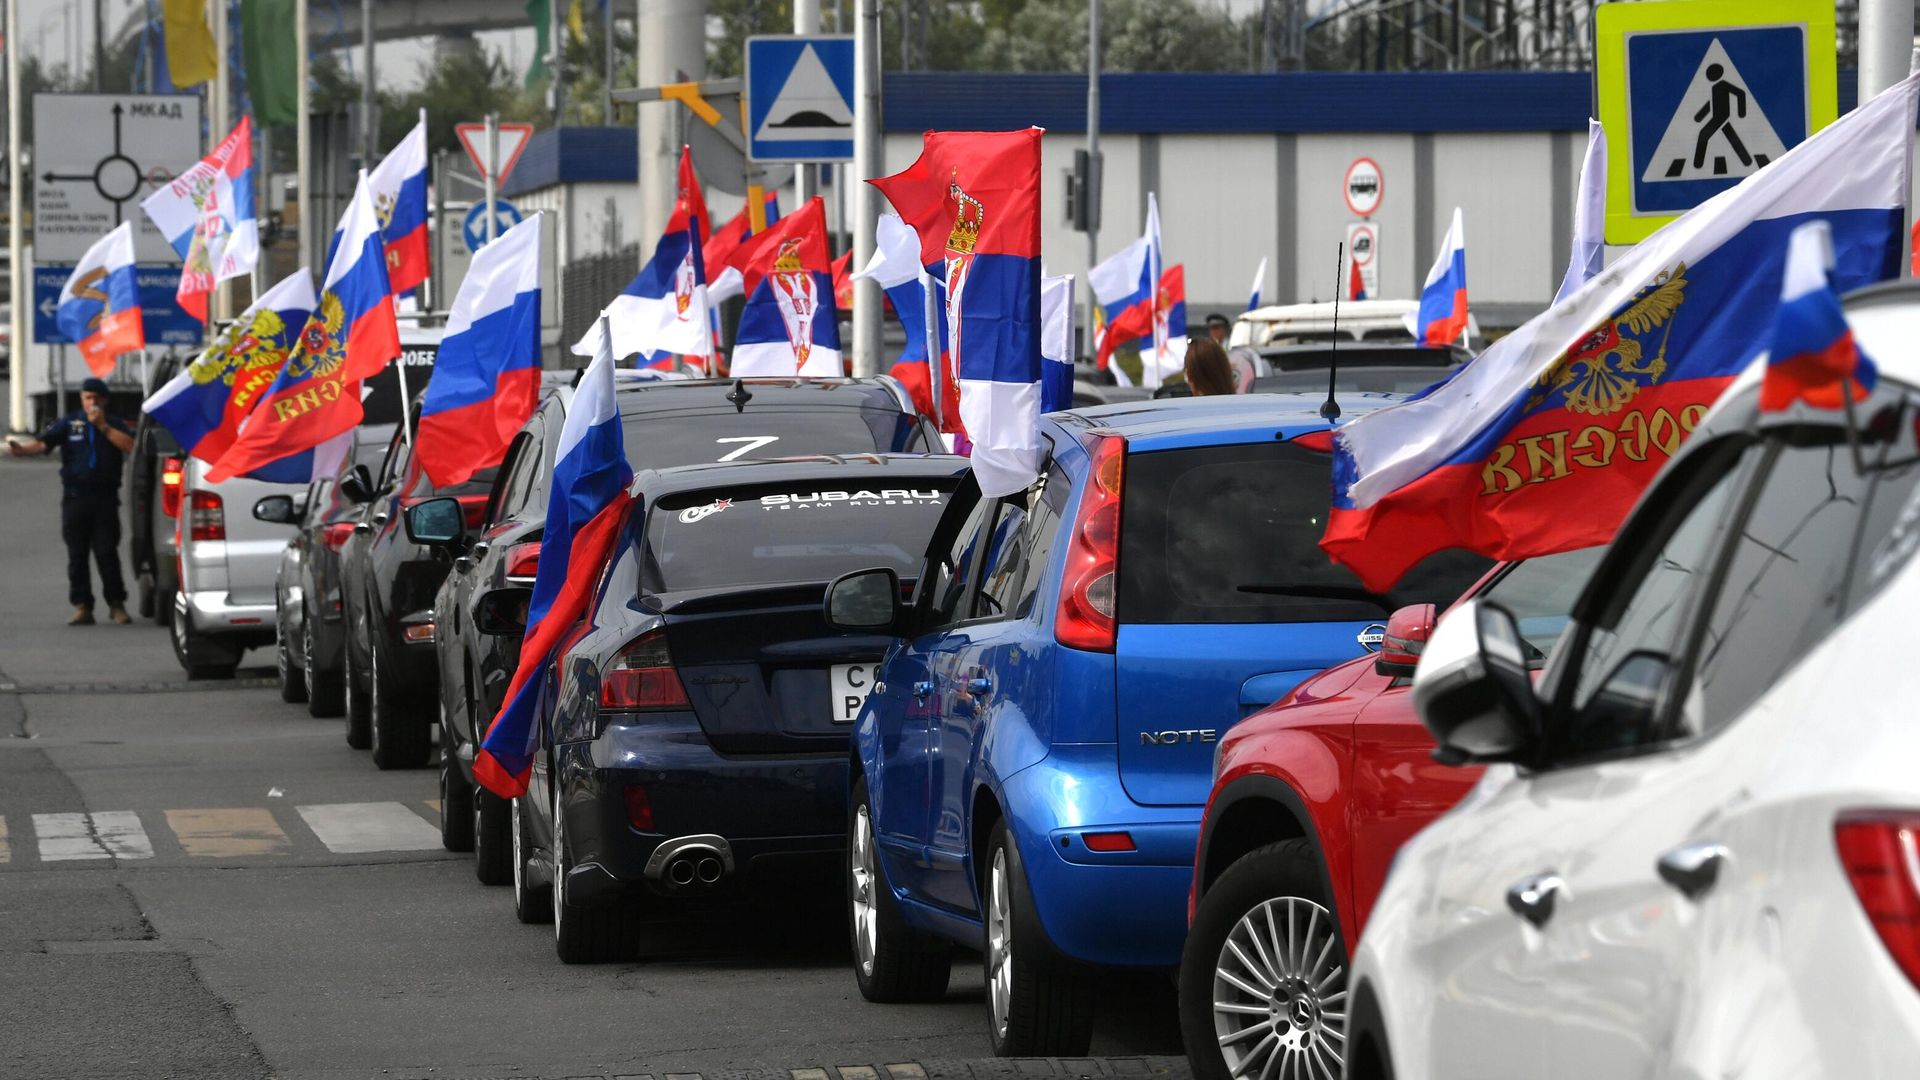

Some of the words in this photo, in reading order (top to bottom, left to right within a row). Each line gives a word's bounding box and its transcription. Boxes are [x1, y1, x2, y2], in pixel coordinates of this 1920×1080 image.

[130, 102, 183, 119] МКАД
[760, 489, 940, 505] SUBARU
[762, 502, 832, 511] TEAM
[845, 695, 867, 718] Р
[1140, 729, 1216, 746] NOTE
